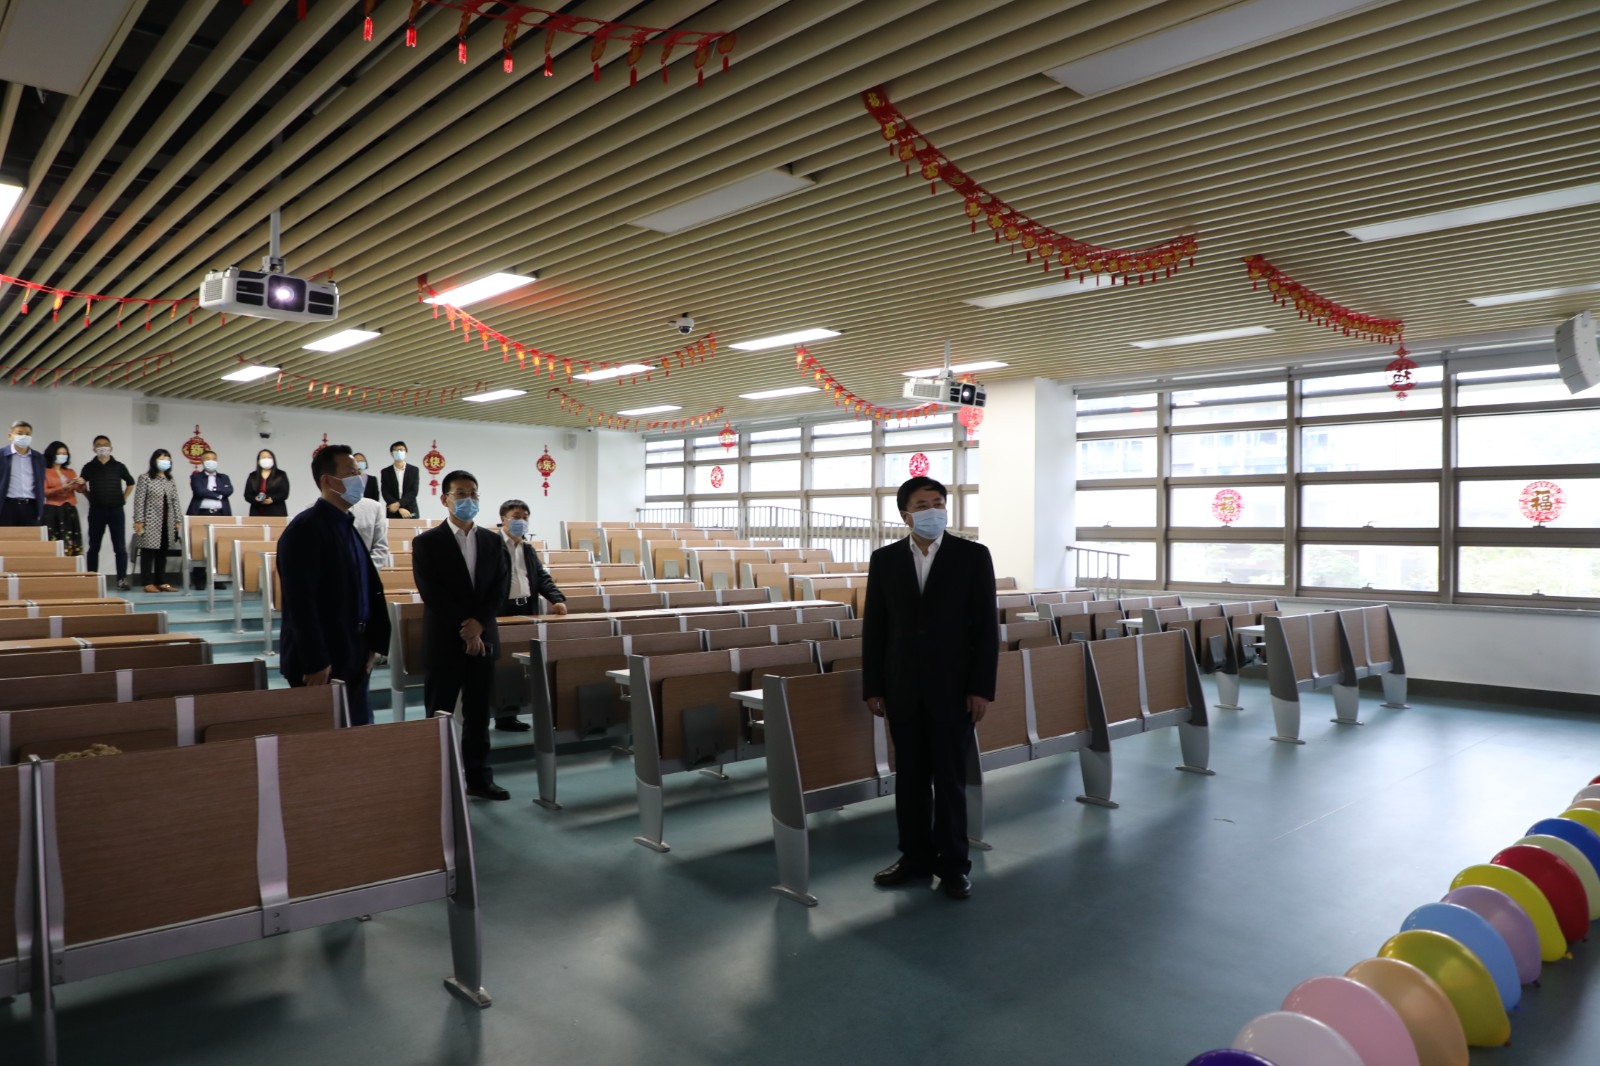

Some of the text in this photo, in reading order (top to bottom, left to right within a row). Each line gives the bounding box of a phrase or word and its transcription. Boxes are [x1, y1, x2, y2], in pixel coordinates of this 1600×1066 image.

[190, 443, 203, 456] 新
[430, 456, 441, 468] 快
[543, 460, 552, 471] 乐
[1219, 496, 1236, 514] 福
[1531, 490, 1553, 511] 福
